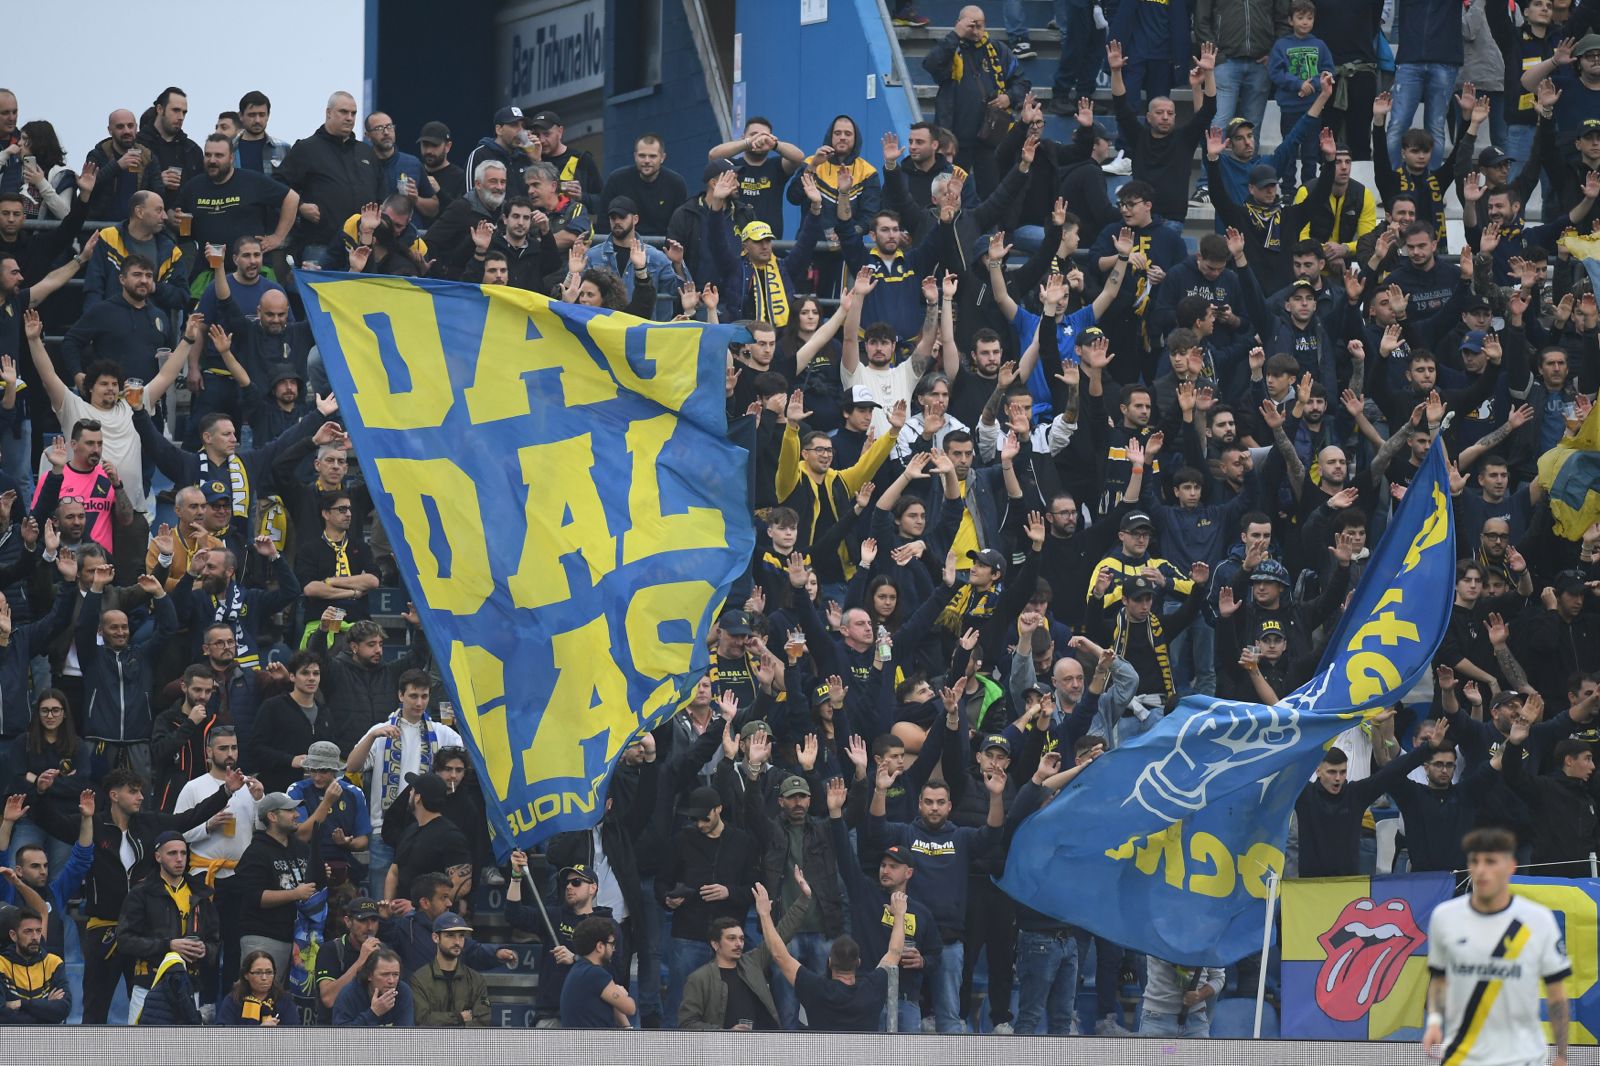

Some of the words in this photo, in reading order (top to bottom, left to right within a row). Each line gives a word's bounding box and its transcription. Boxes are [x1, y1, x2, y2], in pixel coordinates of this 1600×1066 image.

[511, 34, 534, 98] Bar
[308, 277, 704, 431] DAG
[373, 411, 730, 616] DAL
